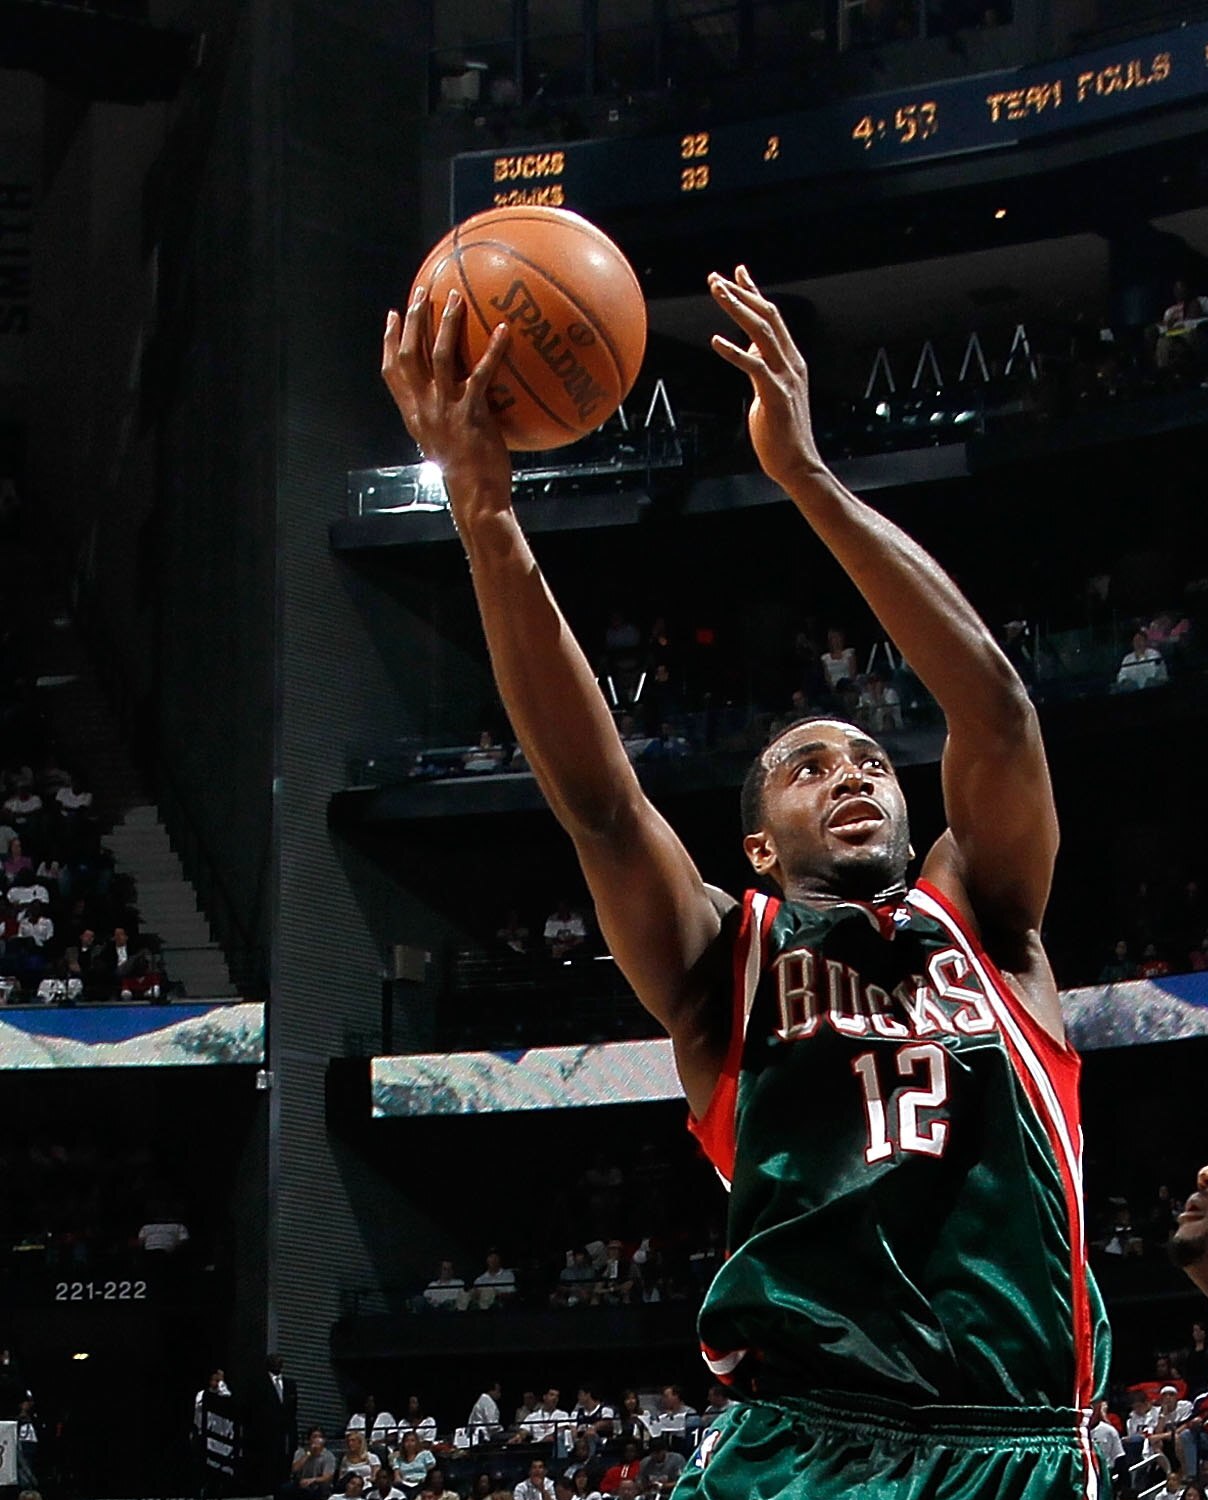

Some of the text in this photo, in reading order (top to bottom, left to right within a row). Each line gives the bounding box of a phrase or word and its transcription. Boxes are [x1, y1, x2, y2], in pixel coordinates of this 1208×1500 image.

[986, 80, 1062, 122] TEAM
[1076, 52, 1172, 102] FOULS
[494, 151, 566, 183] BUCKS
[490, 279, 608, 424] SPALDING
[773, 948, 997, 1040] BUCKS
[853, 1042, 949, 1165] 12
[55, 1281, 148, 1300] 221-222
